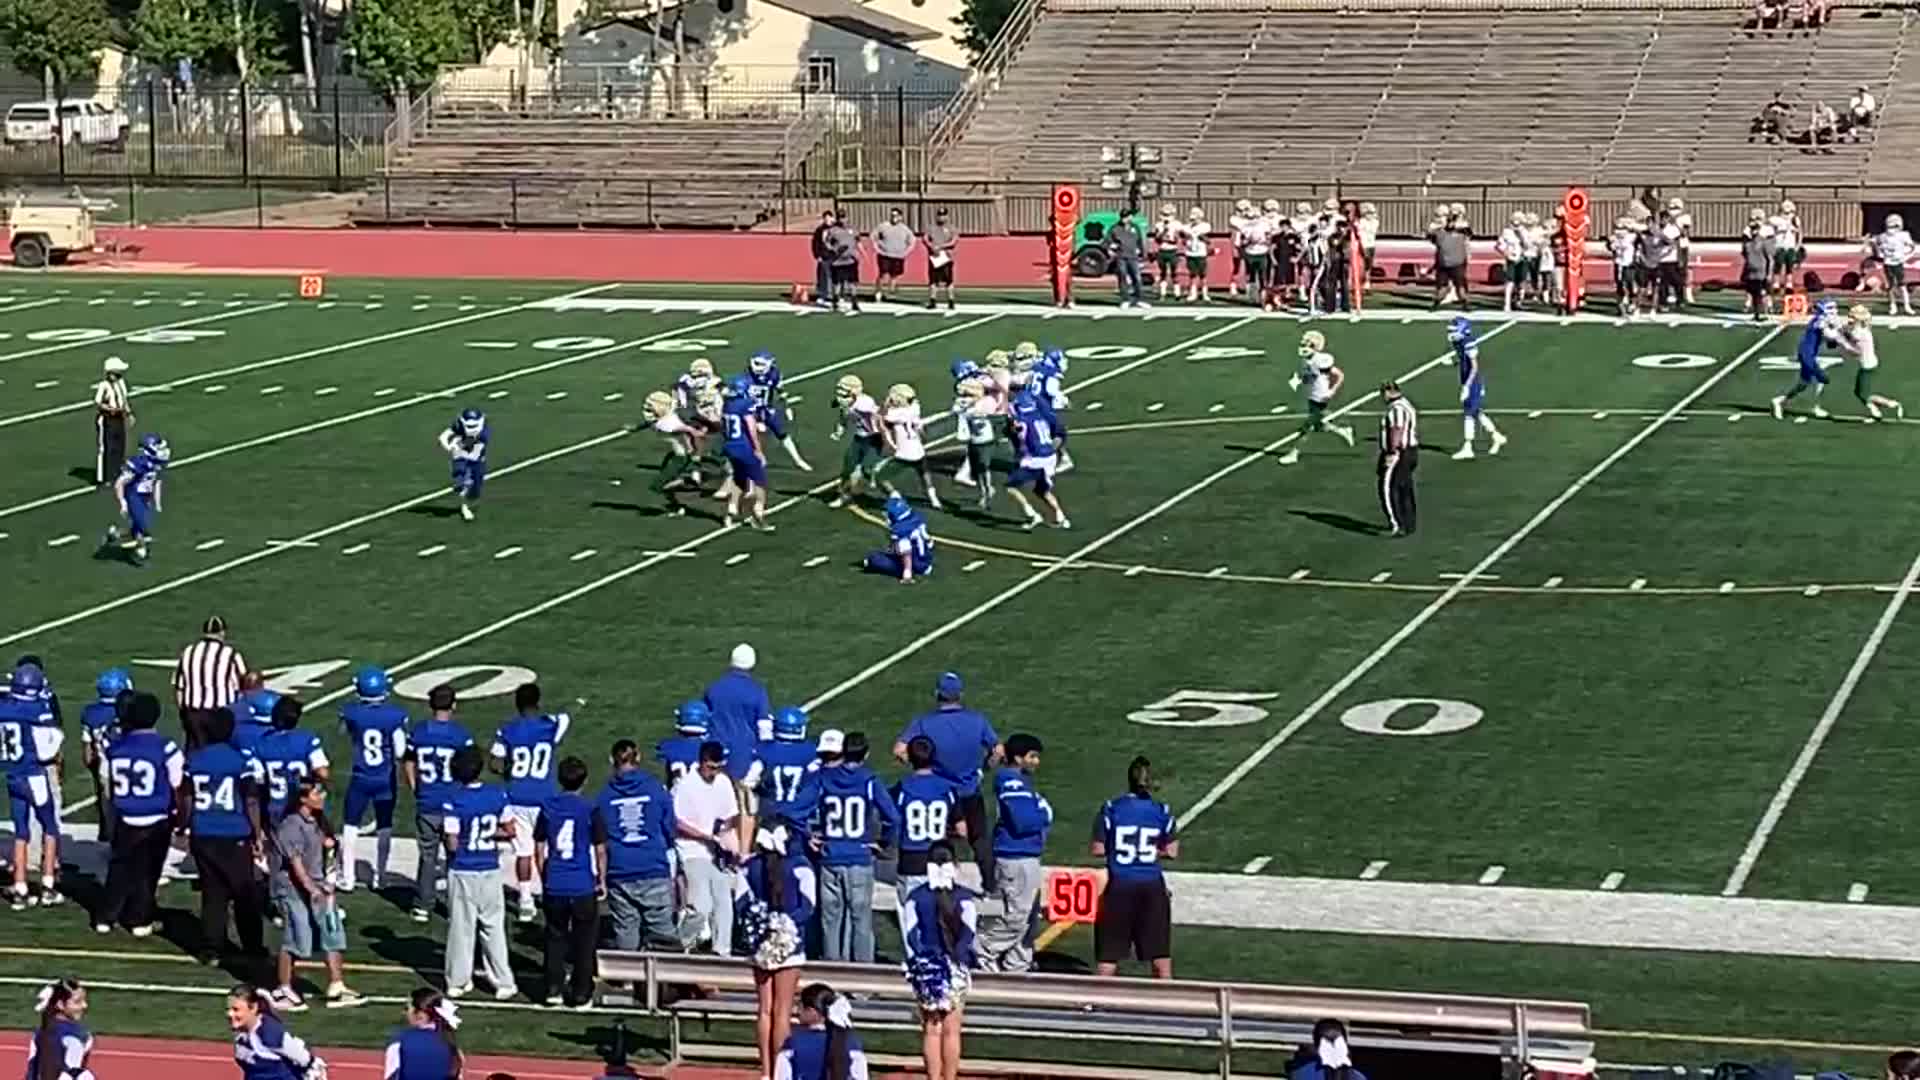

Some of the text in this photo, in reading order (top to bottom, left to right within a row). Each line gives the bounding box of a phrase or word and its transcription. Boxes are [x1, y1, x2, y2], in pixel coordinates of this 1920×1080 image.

[1126, 689, 1485, 735] 50
[363, 728, 384, 766] 8
[416, 746, 456, 783] 57
[511, 742, 552, 779] 80
[111, 758, 156, 797] 53
[192, 774, 235, 812] 54
[773, 765, 804, 802] 17
[467, 813, 498, 851] 12
[823, 795, 866, 839] 20
[905, 800, 948, 842] 88
[556, 819, 577, 860] 4
[1114, 825, 1161, 865] 55
[1053, 875, 1093, 917] 50
